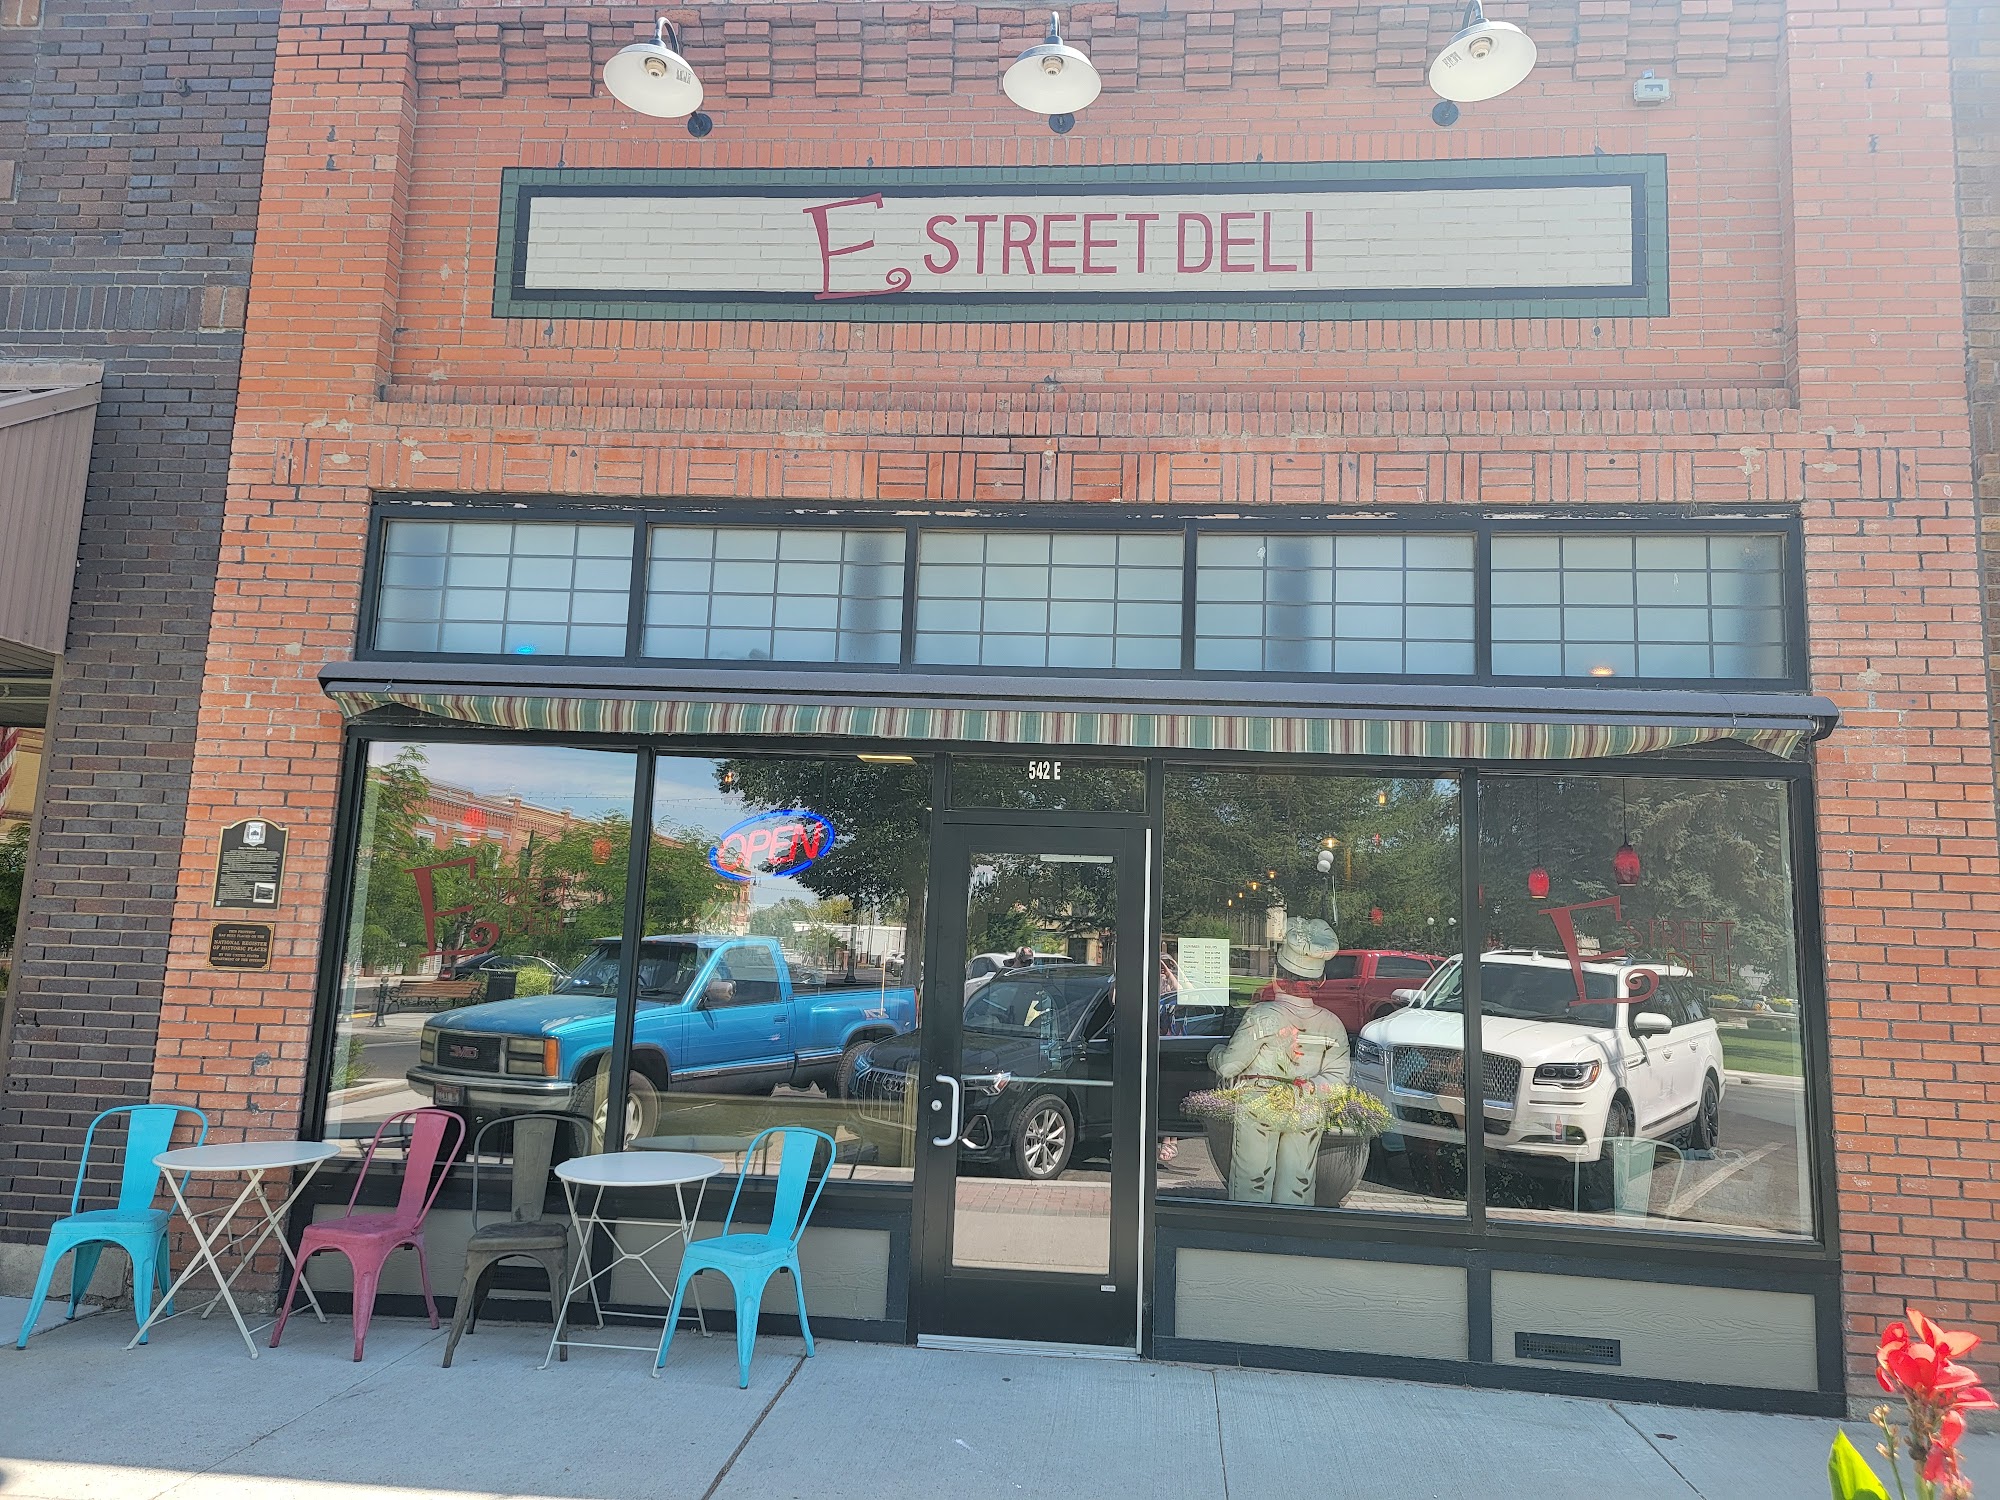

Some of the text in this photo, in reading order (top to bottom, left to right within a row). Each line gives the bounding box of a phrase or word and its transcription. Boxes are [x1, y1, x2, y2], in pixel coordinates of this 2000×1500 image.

[803, 193, 1314, 300] E STREET DELI
[1028, 761, 1062, 780] 542 E
[717, 821, 823, 871] OPEN
[404, 856, 573, 958] E STREET
[505, 907, 567, 936] DELI
[1537, 895, 1736, 1007] E STREET
[1667, 952, 1732, 983] DELI
